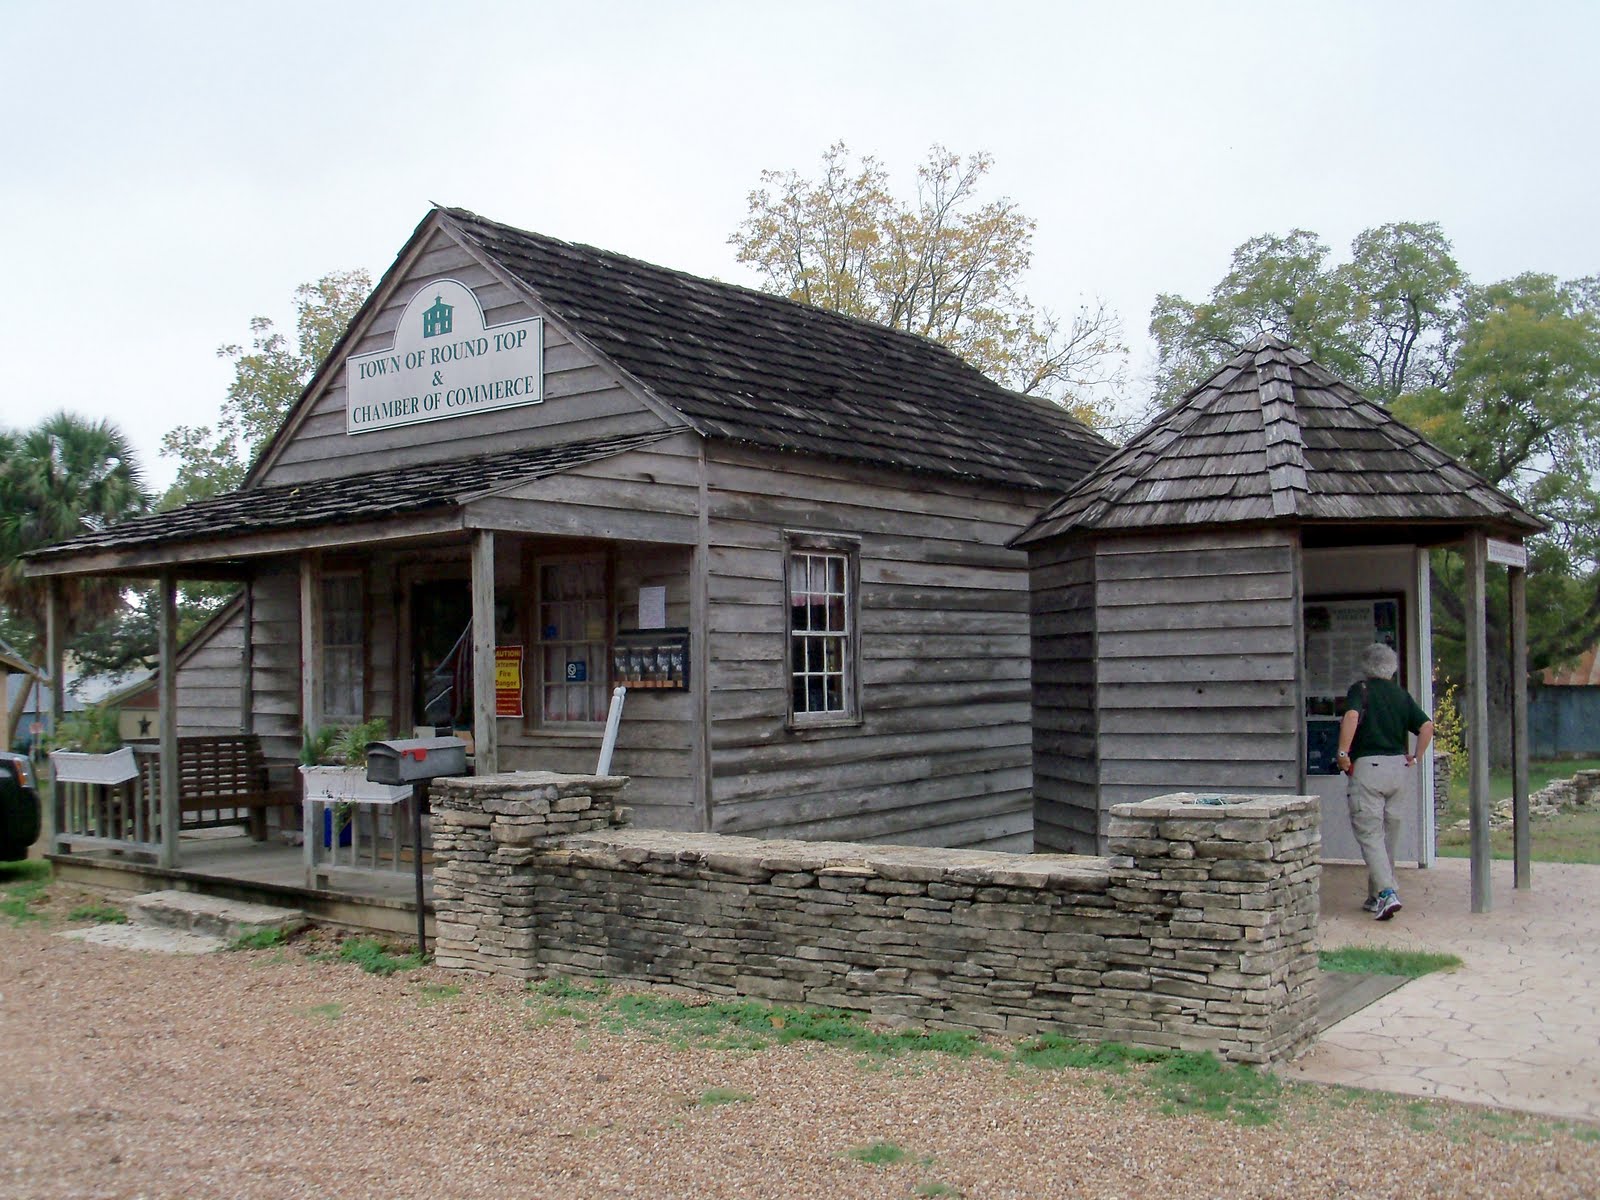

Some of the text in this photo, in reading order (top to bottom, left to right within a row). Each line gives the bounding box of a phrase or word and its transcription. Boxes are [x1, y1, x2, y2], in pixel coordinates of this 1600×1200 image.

[358, 329, 527, 380] TOWN OF ROUND TOP
[432, 370, 444, 387] &
[353, 375, 534, 424] CHAMBER OF COMMERCE
[496, 680, 517, 688] Danger
